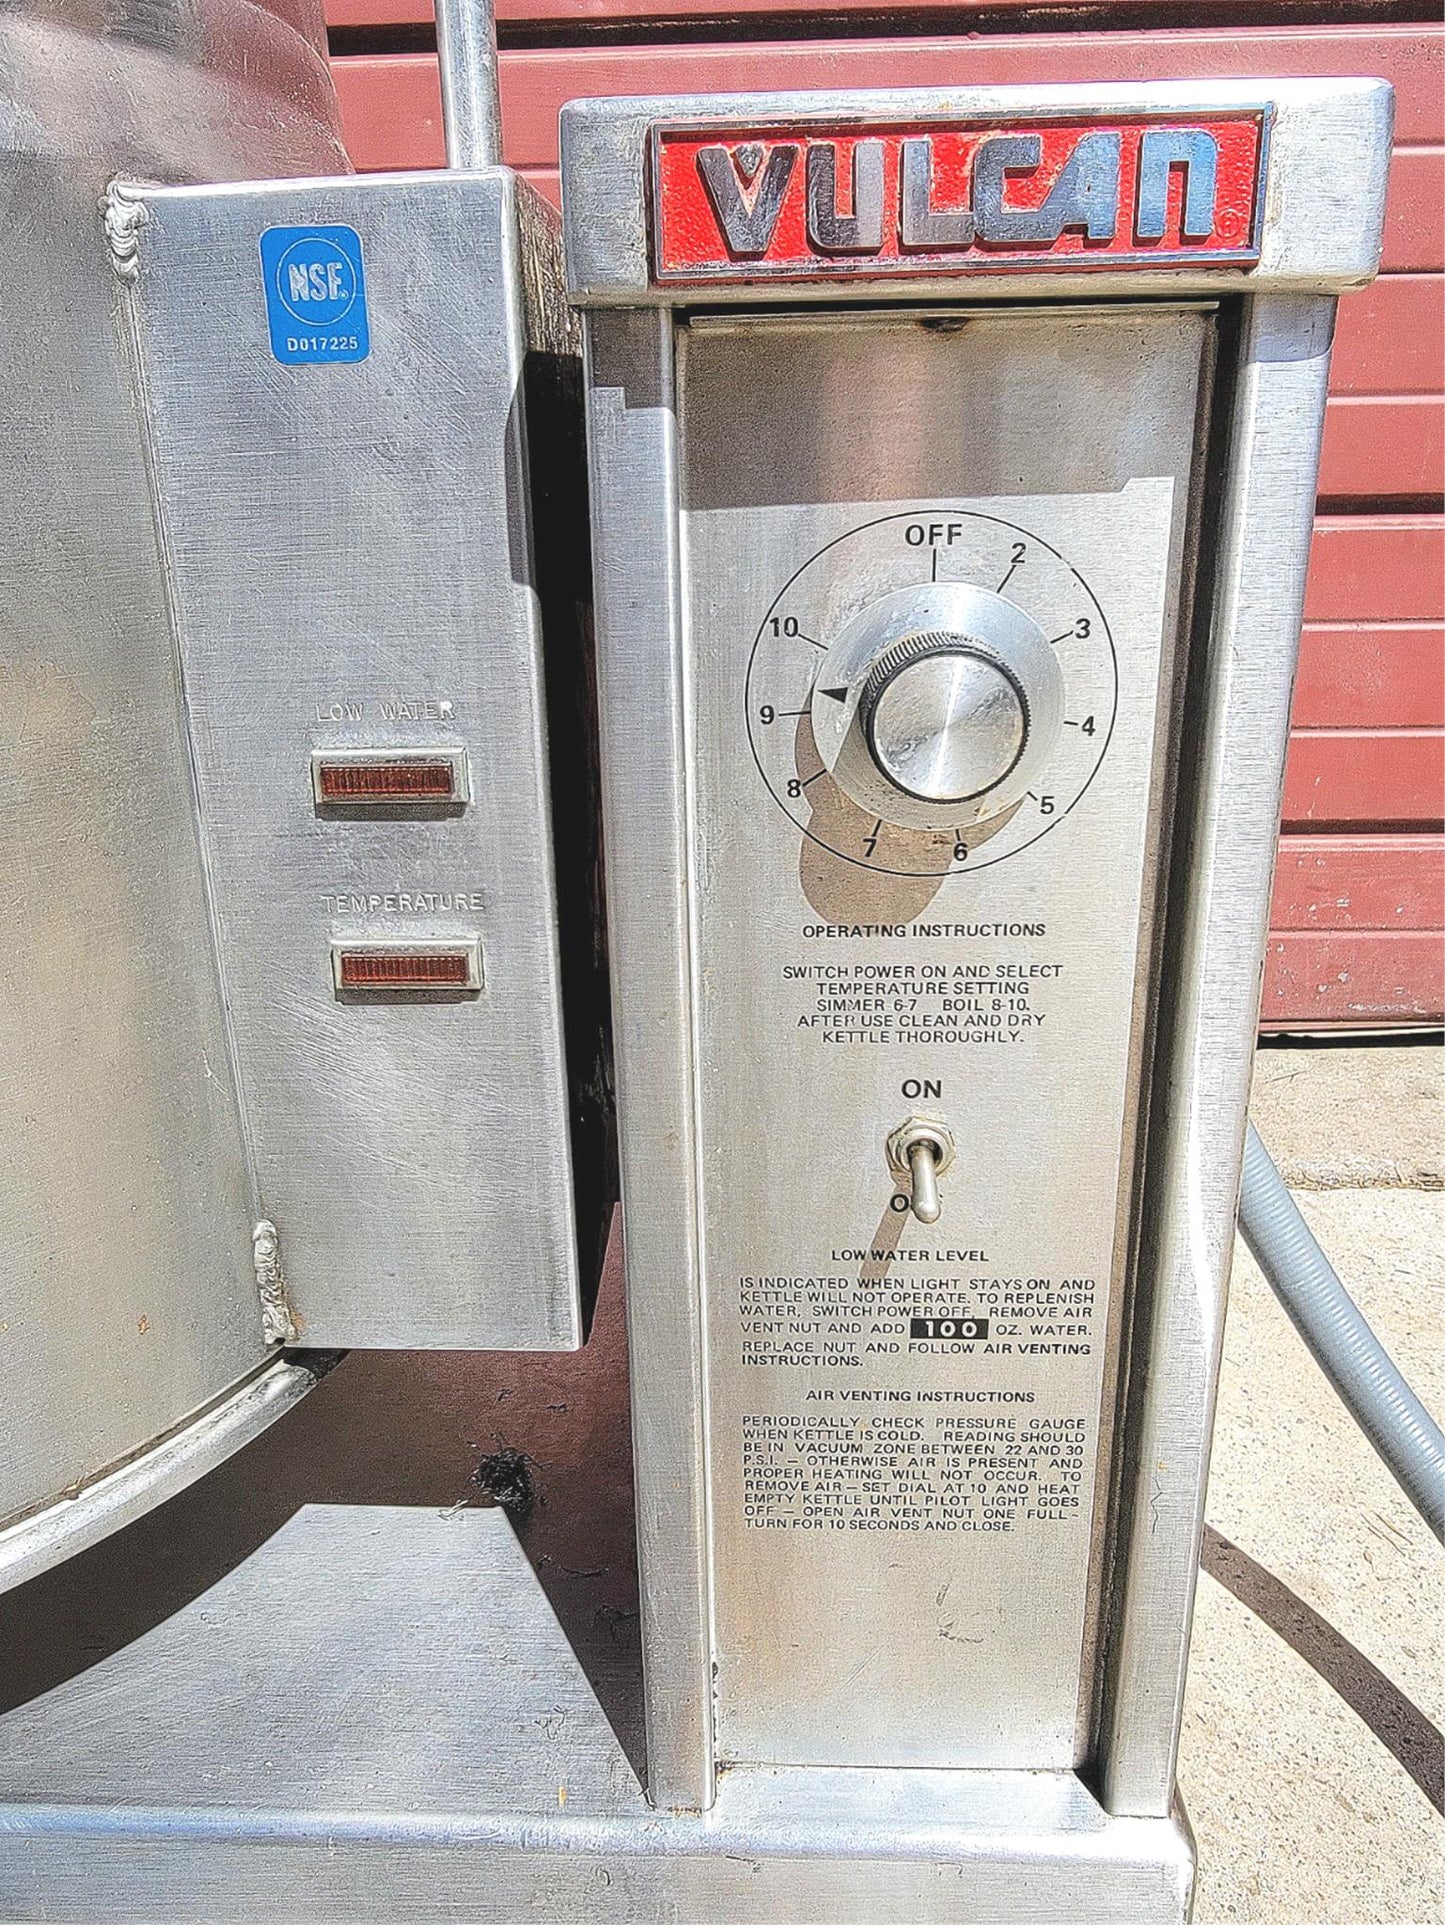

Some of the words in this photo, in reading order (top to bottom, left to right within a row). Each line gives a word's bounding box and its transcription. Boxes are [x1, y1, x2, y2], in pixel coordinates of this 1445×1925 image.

[695, 129, 1219, 253] VULCAN
[289, 263, 343, 301] NSF
[287, 337, 358, 351] D017225
[904, 523, 964, 547] OFF
[1010, 542, 1027, 565] 2
[769, 616, 800, 638] 10
[1074, 618, 1092, 640] 3
[316, 703, 363, 721] LOW
[380, 701, 455, 721] WATER
[759, 705, 775, 725] 9
[1080, 716, 1096, 737] 4
[786, 779, 802, 799] 8
[1039, 796, 1055, 815] 5
[862, 838, 877, 858] 7
[953, 842, 969, 862] 6
[320, 893, 485, 913] TEMPERATURE
[802, 924, 907, 939] OPERATING
[912, 923, 1047, 938] INSTRUCTIONS
[782, 966, 849, 980] SWITCH
[854, 965, 916, 979] POWER
[920, 965, 946, 979] ON
[952, 965, 991, 979] AND
[995, 964, 1064, 978] SELECT
[816, 982, 949, 996] TEMPERATURE
[952, 981, 1030, 995] SETTING
[816, 998, 885, 1012] SIMMER
[942, 998, 984, 1011] BOIL
[991, 998, 1031, 1011] 8-10.
[796, 1014, 856, 1028] AFTER
[860, 1014, 894, 1027] USE
[898, 1014, 958, 1027] CLEAN
[963, 1013, 1002, 1027] AND
[1007, 1013, 1047, 1027] DRY
[822, 1030, 890, 1044] KETTLE
[897, 1030, 1025, 1044] THOROUGHLY.
[901, 1079, 943, 1099] ON
[831, 1249, 867, 1262] LOW
[870, 1249, 930, 1262] WATER
[935, 1250, 990, 1262] LEVEL
[739, 1277, 754, 1290] IS
[759, 1277, 849, 1290] INDICATED
[856, 1277, 905, 1290] WHEN
[910, 1277, 961, 1291] LIGHT
[968, 1278, 1027, 1291] STAYS
[1026, 1278, 1051, 1291] ON
[1059, 1278, 1096, 1291] AND
[739, 1291, 804, 1304] KETTLE
[806, 1291, 848, 1304] WILL
[852, 1291, 886, 1304] NOT
[890, 1291, 971, 1304] OPERATE.
[976, 1292, 999, 1304] TO
[1003, 1292, 1095, 1305] REPLENISH
[739, 1305, 803, 1319] WATER,
[811, 1305, 873, 1318] SWITCH
[877, 1305, 934, 1318] POWER
[937, 1305, 975, 1320] OFF,
[989, 1306, 1058, 1318] REMOVE
[1063, 1306, 1093, 1319] AIR
[740, 1322, 784, 1334] VENT
[788, 1322, 822, 1335] NUT
[827, 1322, 862, 1335] AND
[870, 1322, 906, 1335] ADD
[924, 1320, 979, 1338] 100
[995, 1323, 1023, 1336] OZ.
[1029, 1323, 1093, 1337] WATER.
[742, 1341, 814, 1354] REPLACE
[823, 1341, 857, 1354] NUT
[864, 1341, 900, 1354] AND
[907, 1342, 975, 1355] FOLLOW
[983, 1342, 1012, 1355] AIR
[1016, 1342, 1092, 1355] VENTING
[742, 1354, 864, 1367] INSTRUCTIONS.
[805, 1389, 835, 1402] AIR
[839, 1390, 912, 1403] VENTING
[916, 1390, 1036, 1403] INSTRUCTIONS
[742, 1415, 861, 1428] PERIODICALLY
[871, 1416, 925, 1429] CHECK
[935, 1416, 1017, 1430] PRESSURE
[1028, 1417, 1086, 1430] GAUGE
[742, 1428, 789, 1441] WHEN
[793, 1429, 855, 1441] KETTLE
[859, 1430, 875, 1442] IS
[876, 1430, 925, 1442] COLD.
[943, 1430, 1016, 1443] READING
[1019, 1431, 1086, 1444] SHOULD
[743, 1441, 762, 1454] BE
[766, 1441, 784, 1454] IN
[794, 1442, 864, 1454] VACUUM
[873, 1442, 917, 1455] ZONE
[921, 1443, 996, 1456] BETWEEN
[1004, 1444, 1023, 1456] 22
[1026, 1444, 1061, 1457] AND
[1065, 1444, 1084, 1457] 30
[743, 1454, 779, 1467] P.S.I.
[806, 1454, 898, 1468] OTHERWISE
[907, 1455, 937, 1468] AIR
[946, 1456, 961, 1468] IS
[967, 1456, 1039, 1469] PRESENT
[1048, 1457, 1084, 1470] AND
[743, 1467, 804, 1480] PROPER
[811, 1468, 883, 1481] HEATING
[891, 1469, 931, 1481] WILL
[940, 1469, 973, 1482] NOT
[983, 1469, 1043, 1482] OCCUR.
[1059, 1470, 1083, 1482] TO
[744, 1480, 810, 1493] REMOVE
[814, 1480, 843, 1493] AIR
[862, 1481, 892, 1493] SET
[898, 1481, 937, 1494] DIAL
[942, 1482, 967, 1494] AT
[970, 1482, 987, 1495] 10
[994, 1482, 1030, 1495] AND
[1037, 1483, 1082, 1496] HEAT
[744, 1493, 796, 1505] EMPTY
[802, 1493, 863, 1506] KETTLE
[869, 1494, 918, 1506] UNTIL
[924, 1494, 972, 1507] PILOT
[981, 1495, 1029, 1507] LIGHT
[1036, 1495, 1080, 1508] GOES
[744, 1505, 776, 1517] OFF
[802, 1505, 844, 1518] OPEN
[852, 1506, 881, 1518] AIR
[890, 1507, 933, 1519] VENT
[942, 1507, 975, 1520] NUT
[982, 1508, 1016, 1520] ONE
[744, 1518, 788, 1530] TURN
[792, 1518, 824, 1530] FOR
[829, 1518, 846, 1530] 10
[848, 1519, 921, 1532] SECONDS
[923, 1519, 958, 1532] AND
[961, 1520, 1016, 1532] CLOSE.
